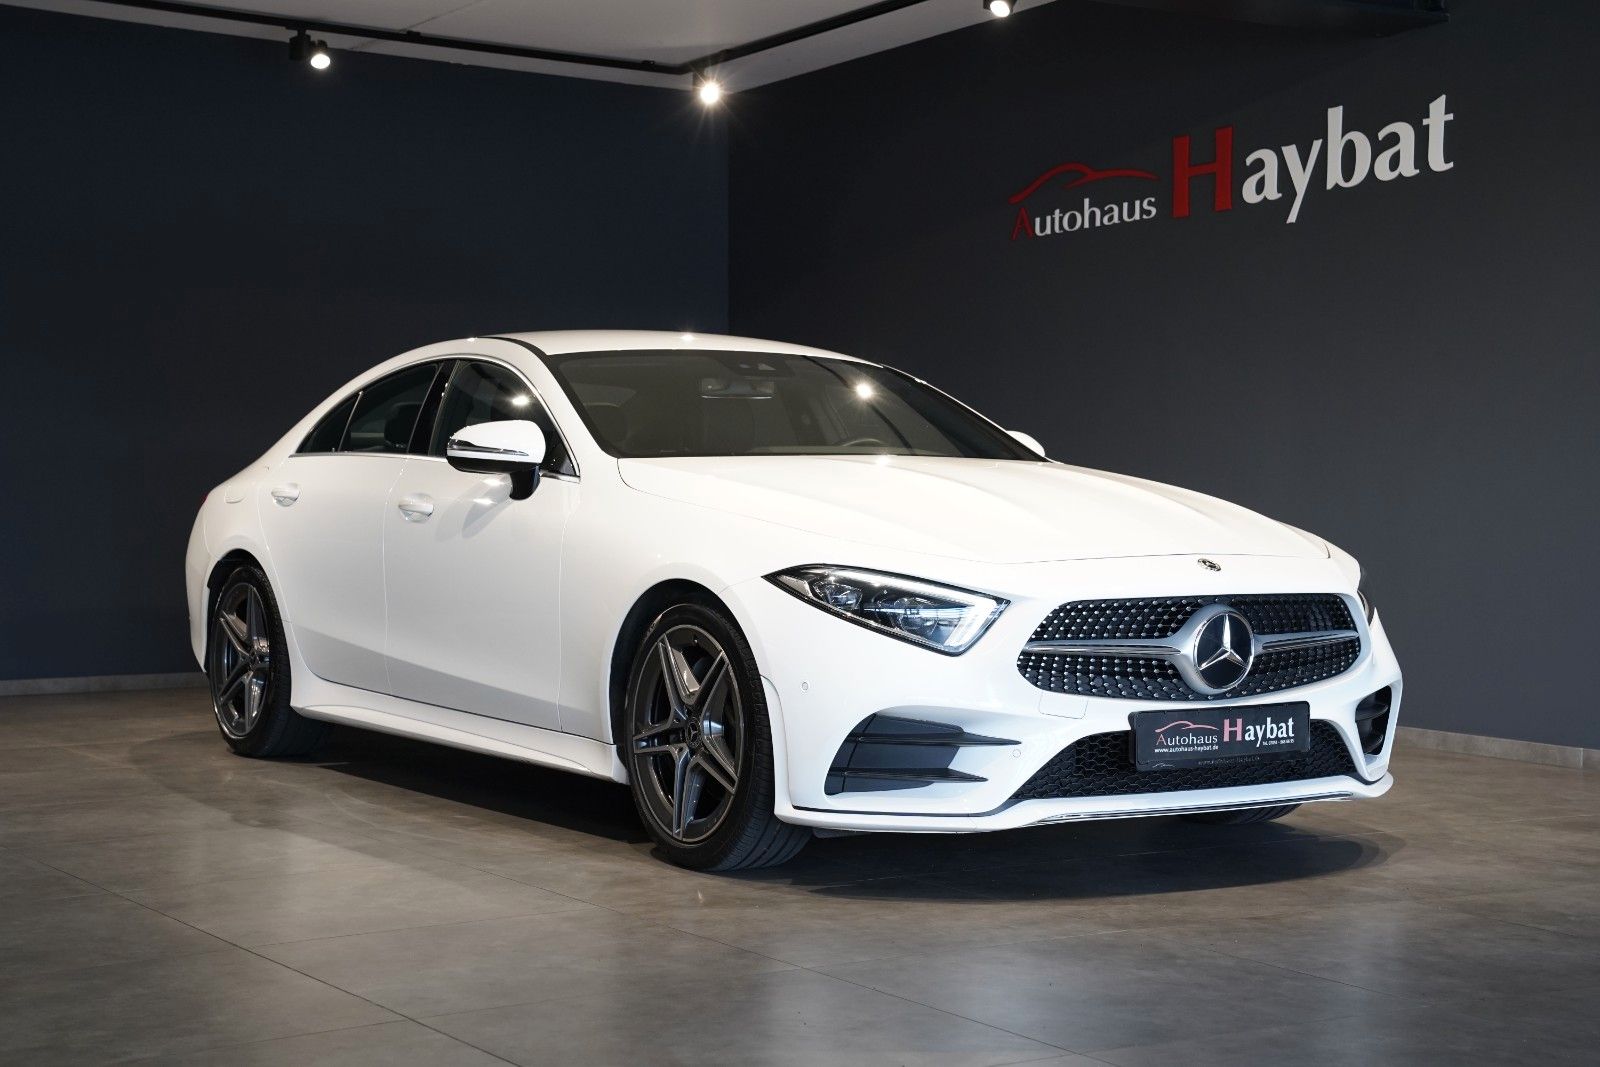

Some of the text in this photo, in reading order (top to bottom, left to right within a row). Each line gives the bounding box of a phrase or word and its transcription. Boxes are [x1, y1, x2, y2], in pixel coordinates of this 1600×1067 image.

[1011, 94, 1454, 241] Autohaus Haybat
[1155, 717, 1295, 747] Autohaus Haybat
[1154, 745, 1219, 753] www.autohaus-haybat.de
